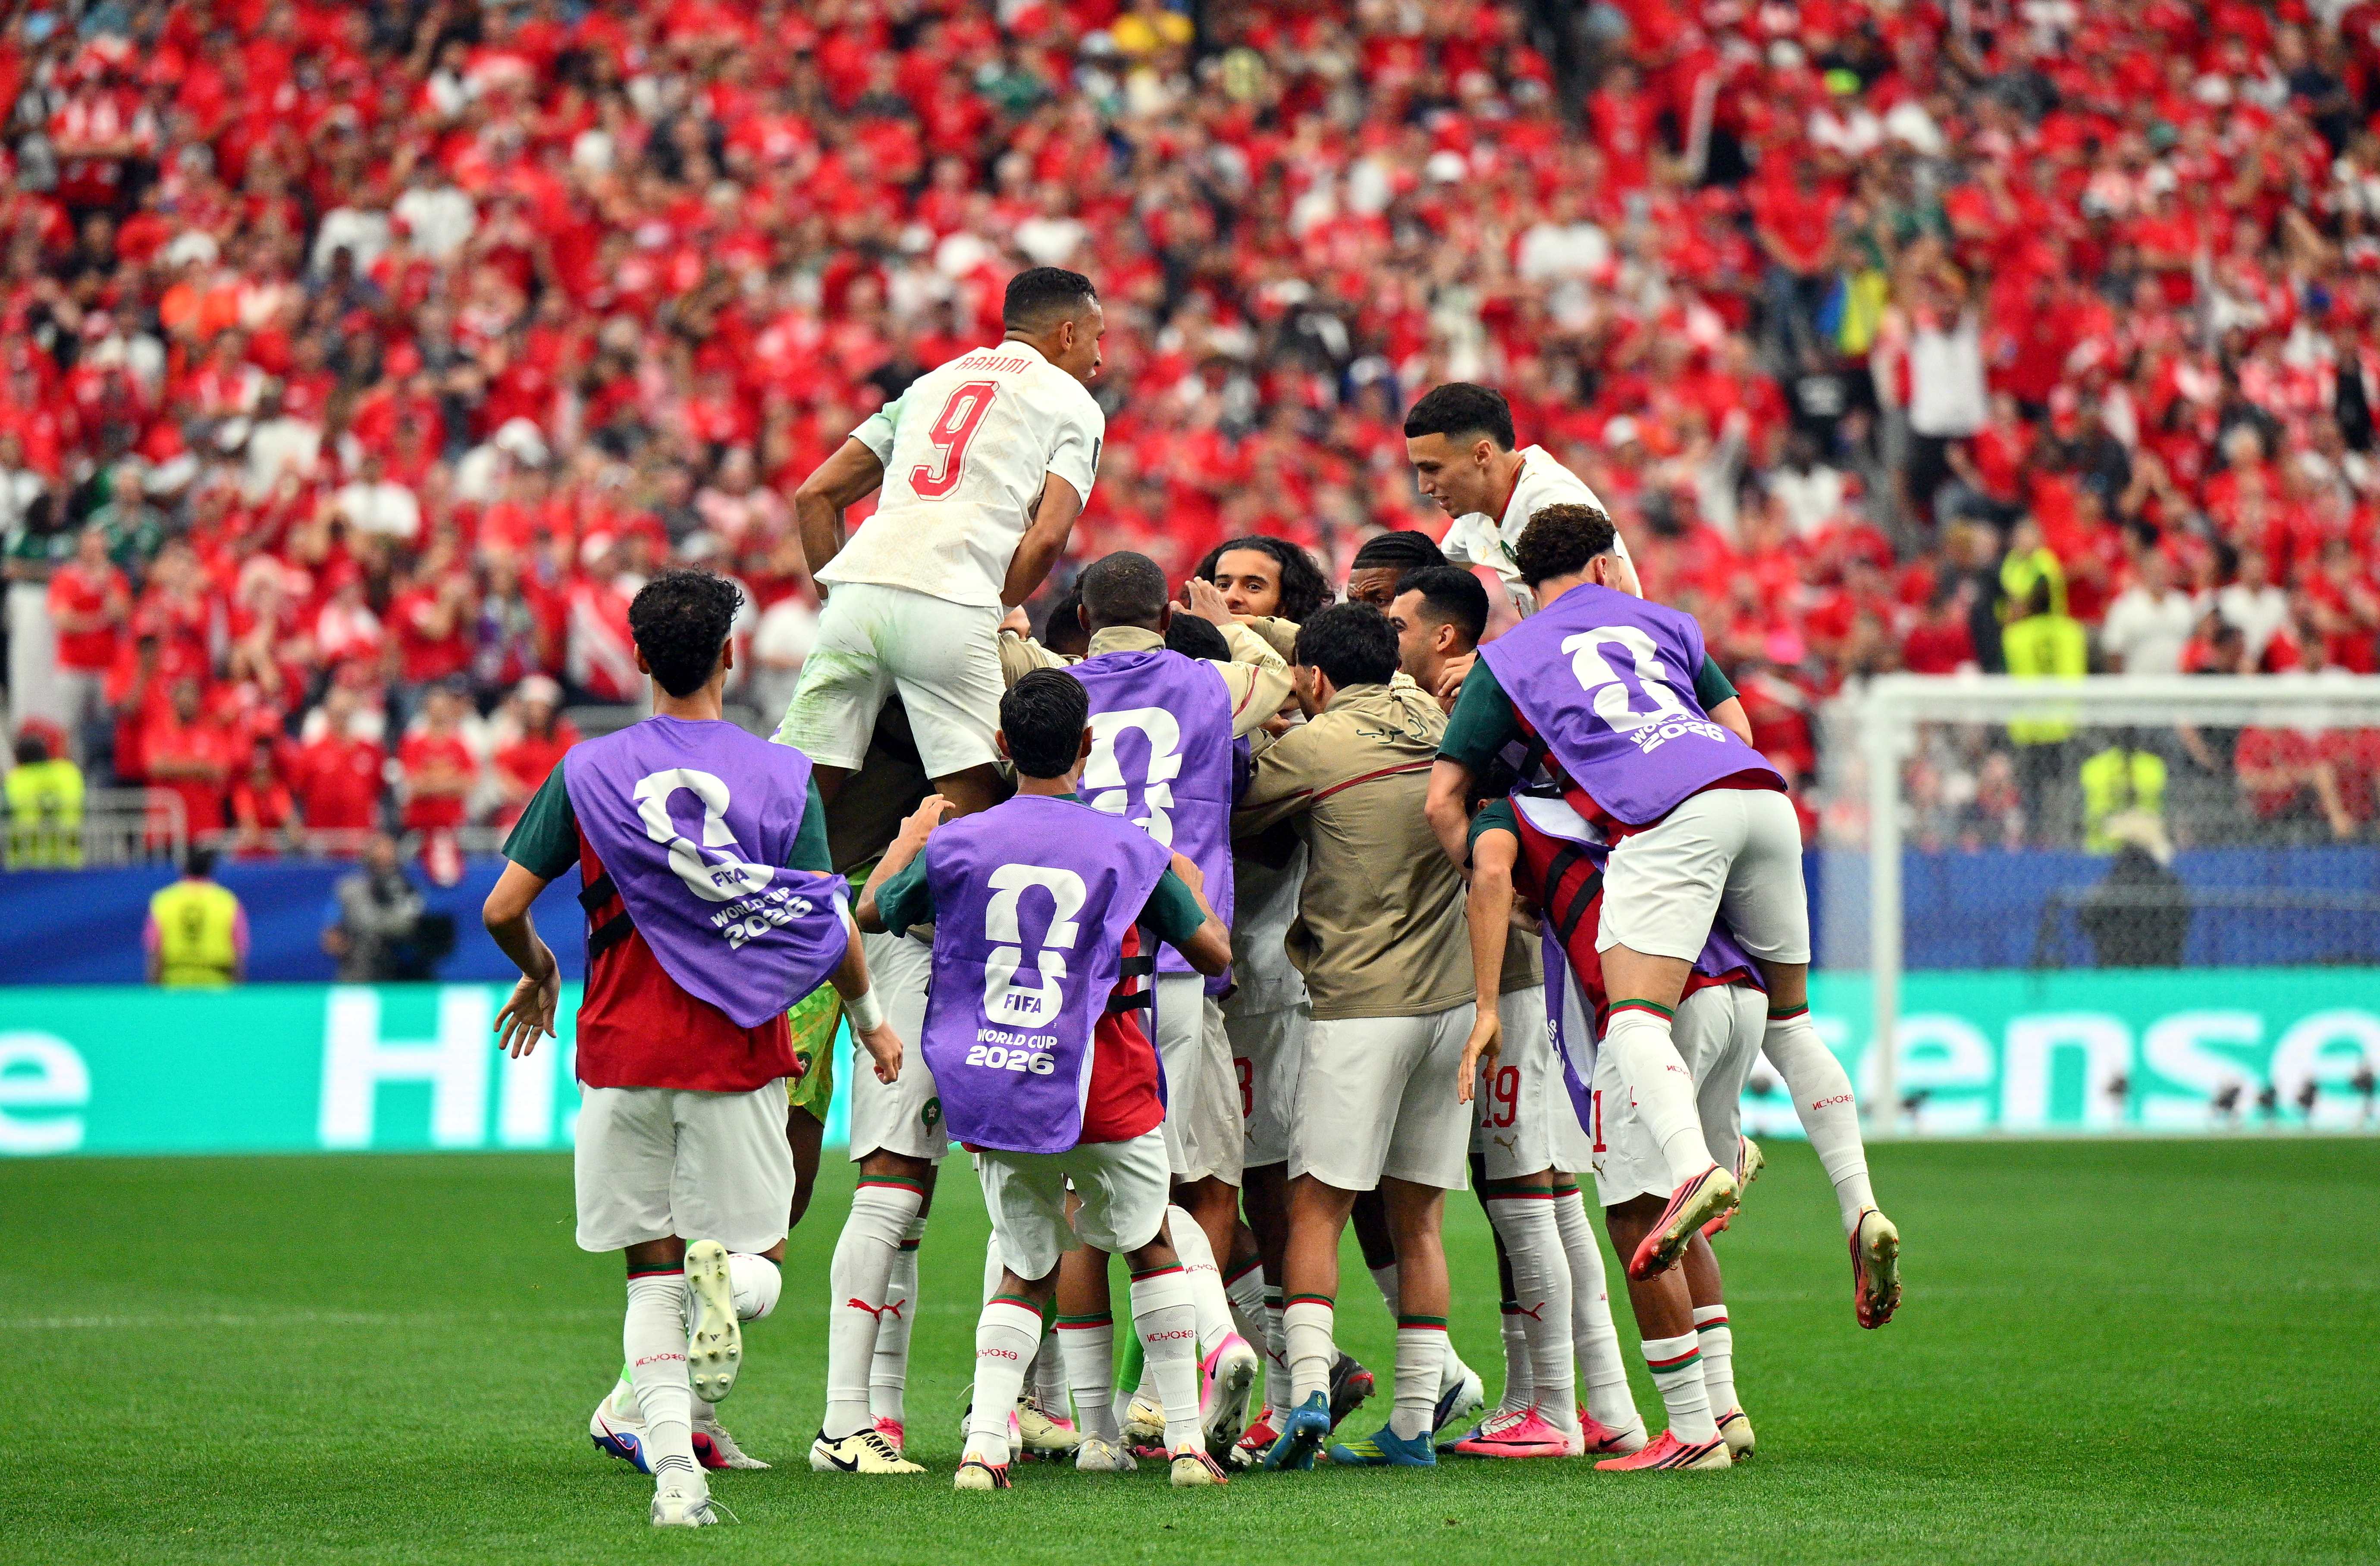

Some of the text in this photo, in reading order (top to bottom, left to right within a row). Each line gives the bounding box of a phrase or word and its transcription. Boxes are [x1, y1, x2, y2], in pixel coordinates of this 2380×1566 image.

[954, 357, 1033, 374] RAHIMI
[908, 381, 1000, 502] 9
[1639, 718, 1726, 754] 2026
[710, 887, 790, 928] WORLD CUP
[724, 896, 813, 950] 2026
[1003, 993, 1041, 1014] FIFA
[977, 1028, 1058, 1049] WORLD CUP
[965, 1045, 1055, 1075] 2026
[1482, 1064, 1520, 1128] 19
